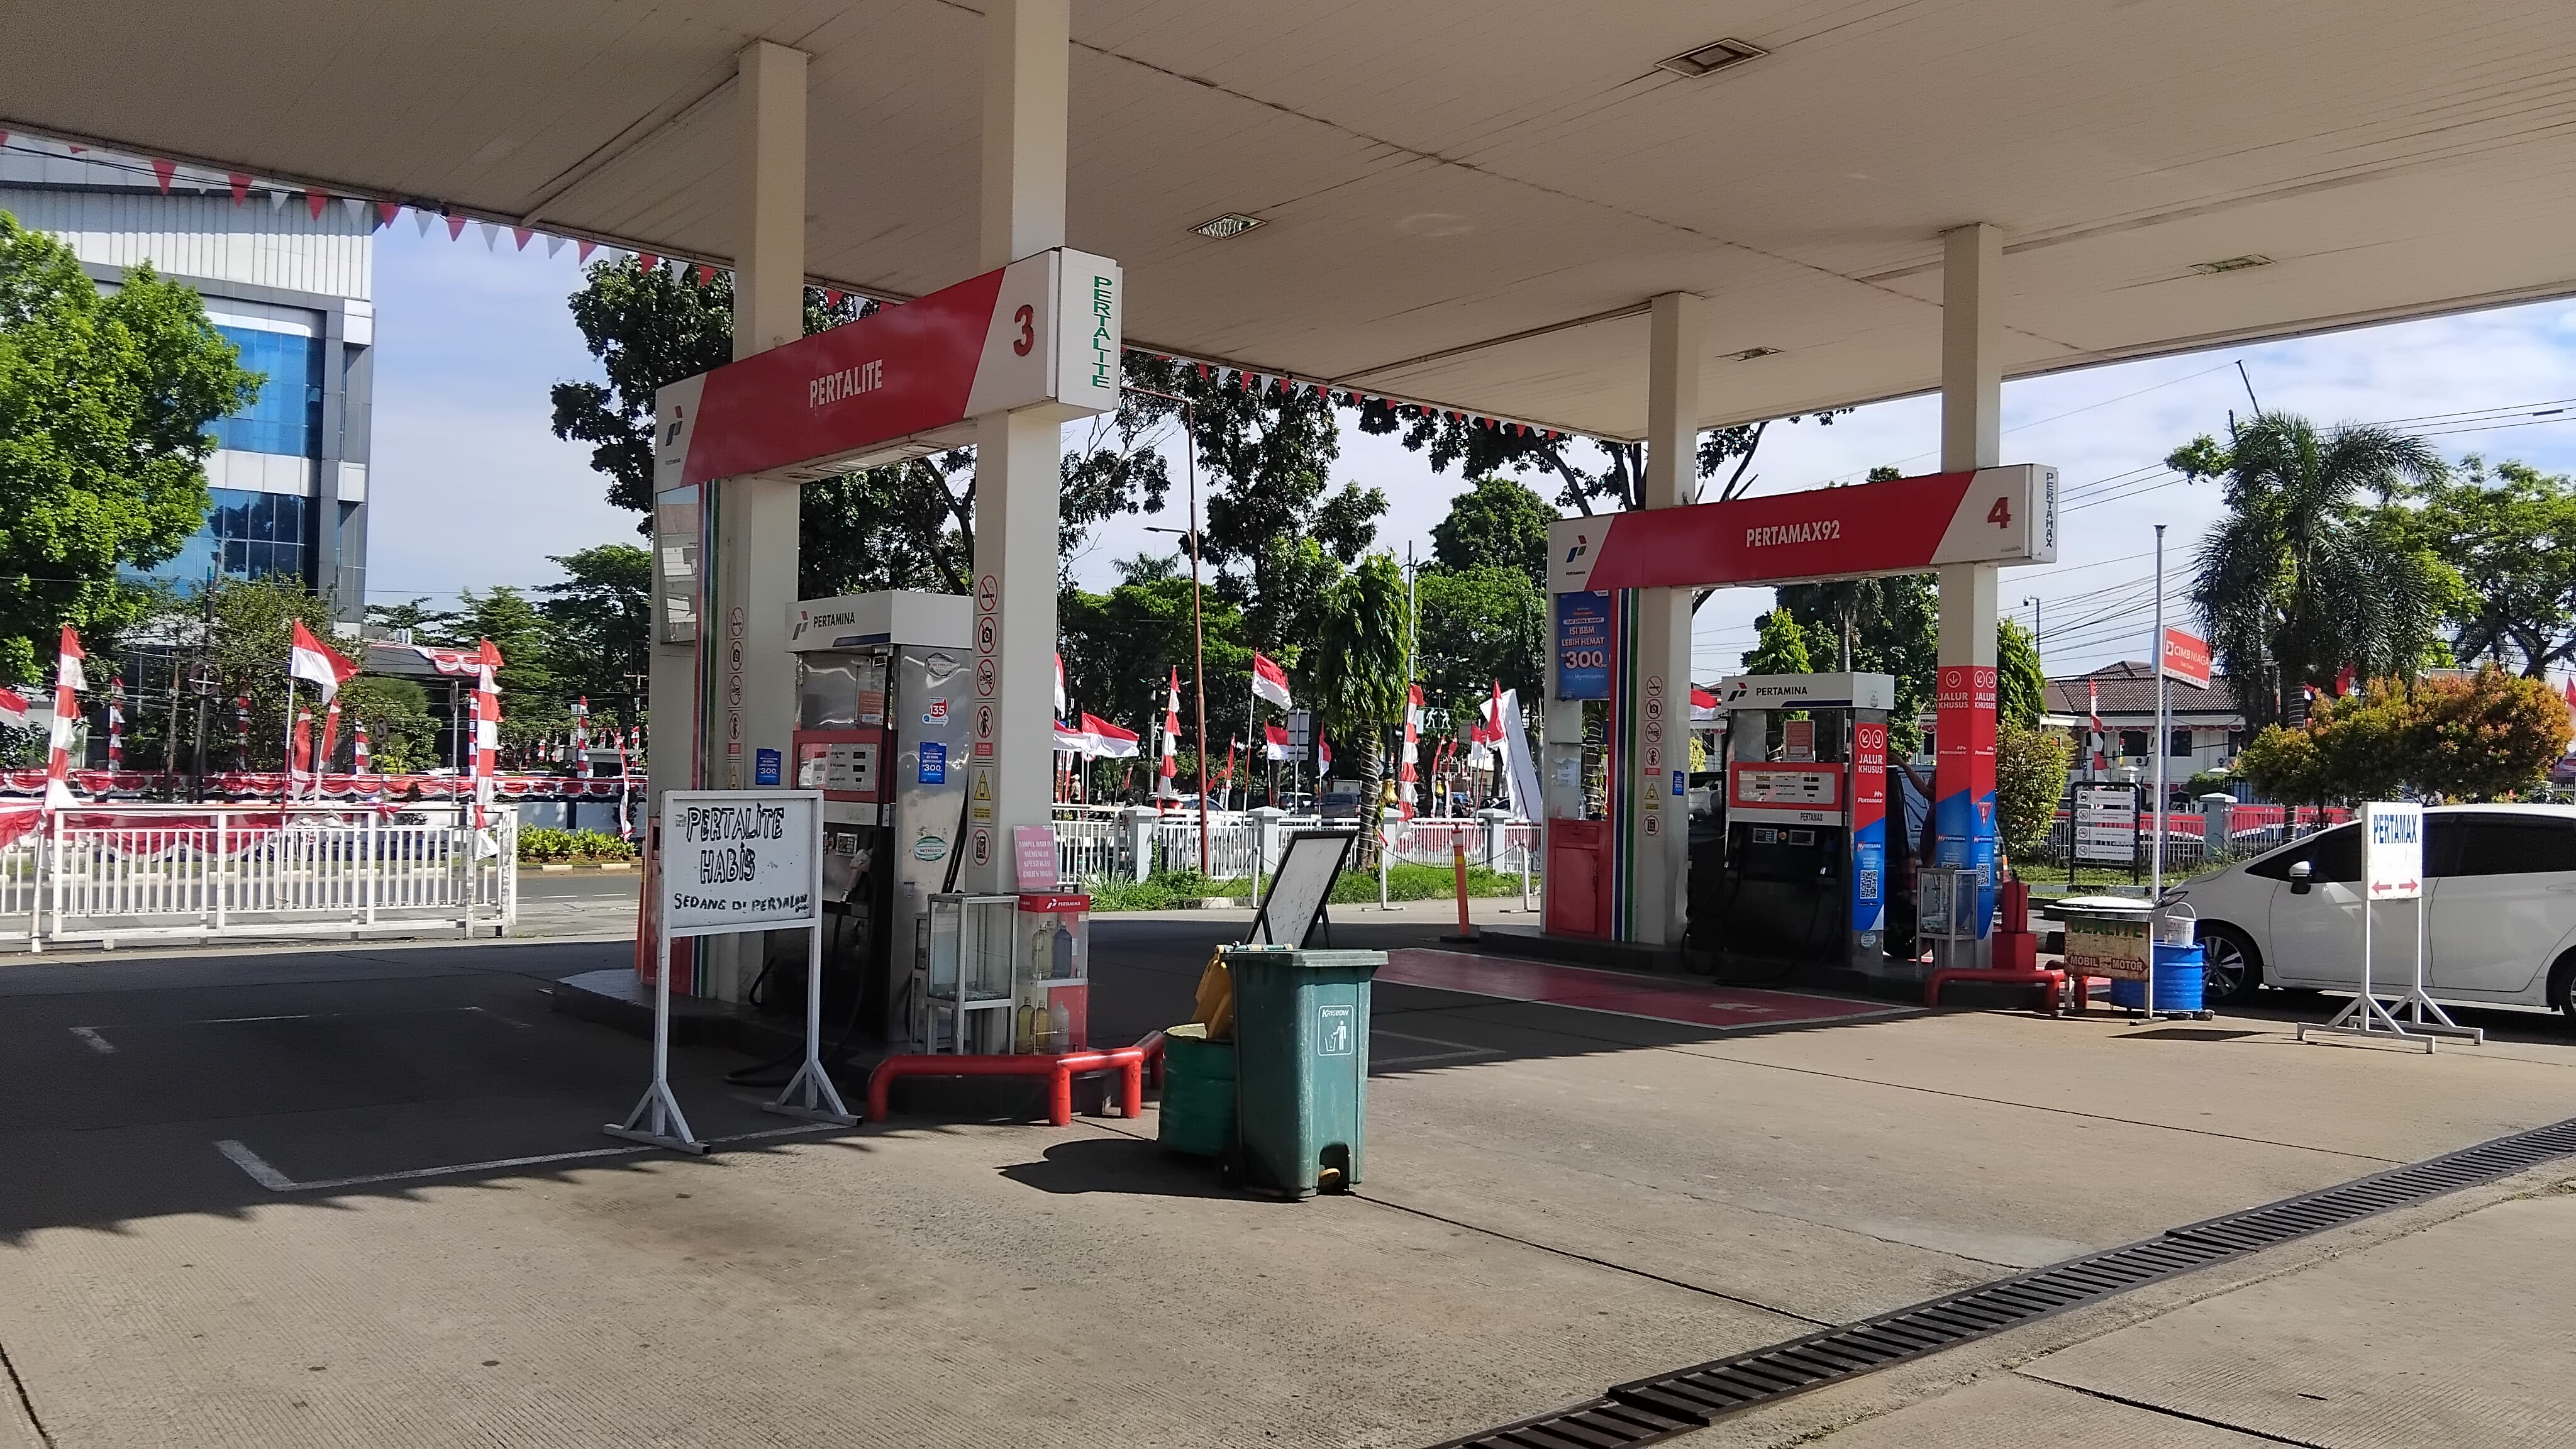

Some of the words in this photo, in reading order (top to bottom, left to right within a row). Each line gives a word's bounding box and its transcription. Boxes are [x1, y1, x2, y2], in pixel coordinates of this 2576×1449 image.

[1013, 304, 1035, 357] 3
[1092, 275, 1113, 389] PERTALITE
[809, 359, 883, 408] PERTALITE
[1987, 497, 2011, 530] 4
[2045, 472, 2054, 548] PERTAMAX
[1746, 520, 1840, 547] PERTAMAX92
[813, 611, 855, 628] PERTAMINA
[1569, 627, 1577, 635] ISI
[1579, 626, 1596, 635] BBM
[1562, 638, 1580, 647] LEBIH
[1580, 636, 1604, 645] HEMAT
[1565, 650, 1603, 669] 300
[2174, 645, 2190, 658] CIMB
[2190, 652, 2209, 667] NIAGA
[1756, 686, 1807, 696] PERTAMINA
[1939, 692, 1968, 701] JALUR
[1975, 692, 1996, 701] JALUR
[1858, 754, 1882, 765] JALUR
[1858, 765, 1883, 774] KHUSUS
[1801, 813, 1823, 821] PERTAMAX
[2373, 814, 2417, 844] PERTAMAX
[2070, 955, 2099, 967] MOBIL
[2112, 959, 2143, 970] MOTOR
